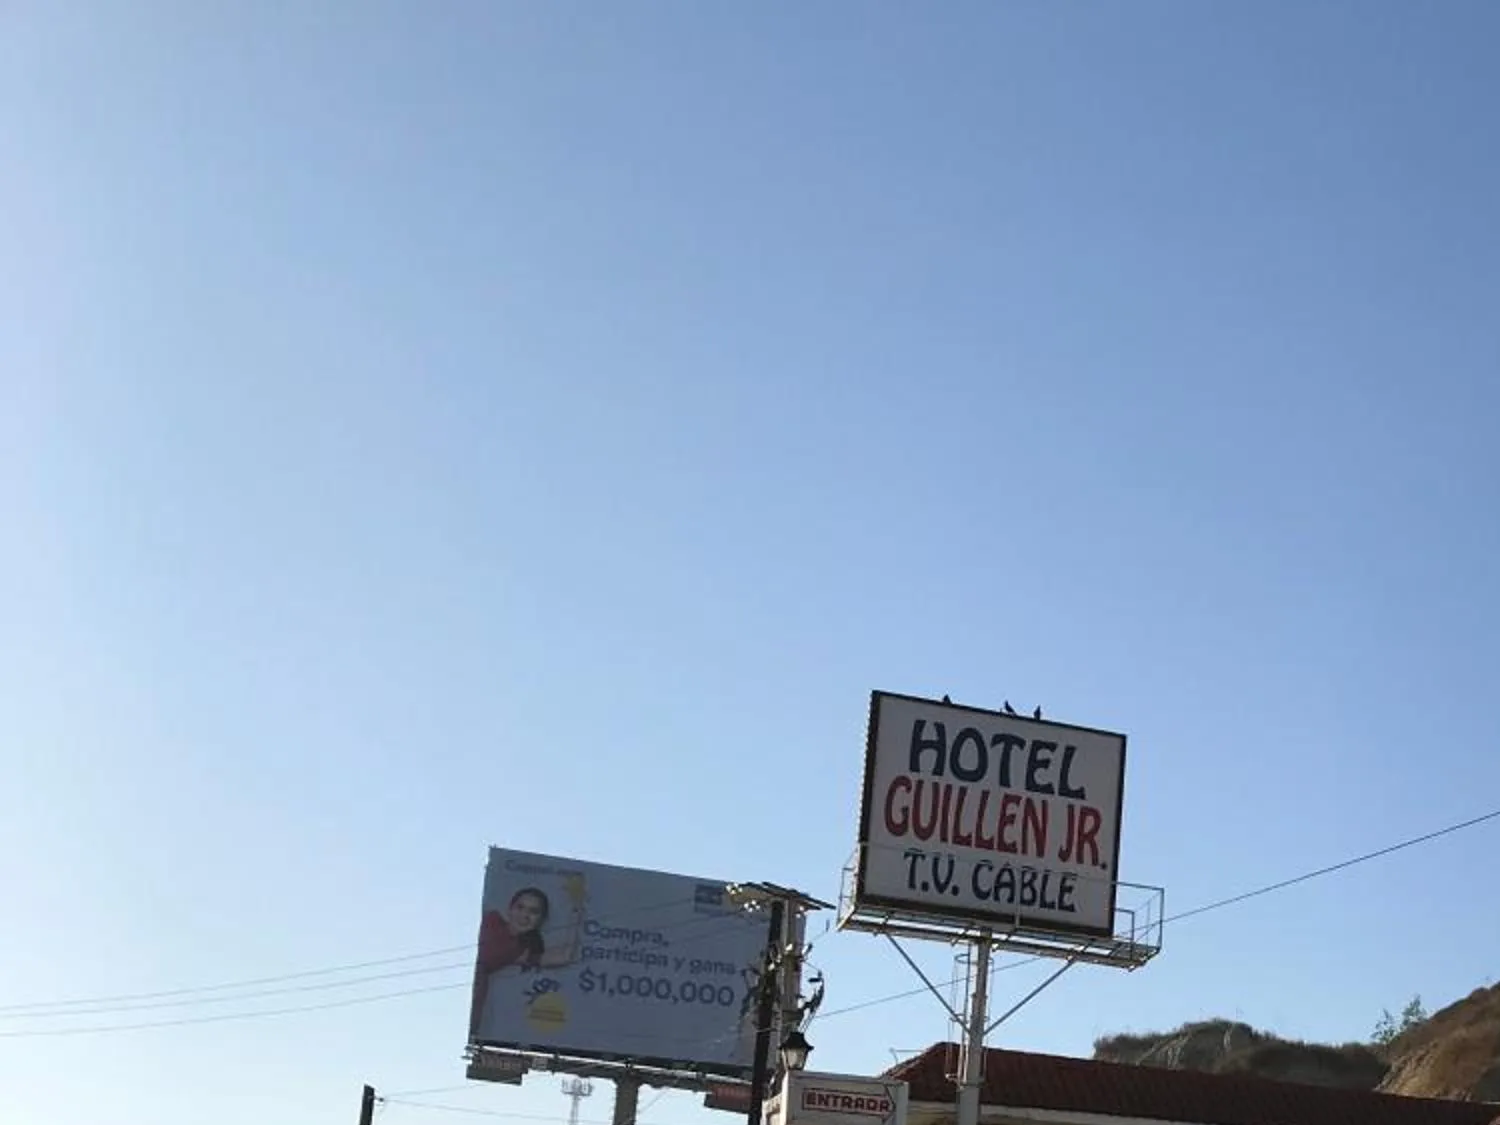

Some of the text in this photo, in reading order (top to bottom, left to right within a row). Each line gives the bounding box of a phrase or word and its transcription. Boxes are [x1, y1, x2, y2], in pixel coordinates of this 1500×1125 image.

[908, 719, 1085, 800] HOTEL
[884, 775, 1108, 871] GUILLEN JR.
[903, 848, 1078, 913] T.V. CABLE
[580, 944, 737, 975] participa y gana
[578, 967, 736, 1007] $1,000,000
[805, 1092, 891, 1113] ENTRADA
